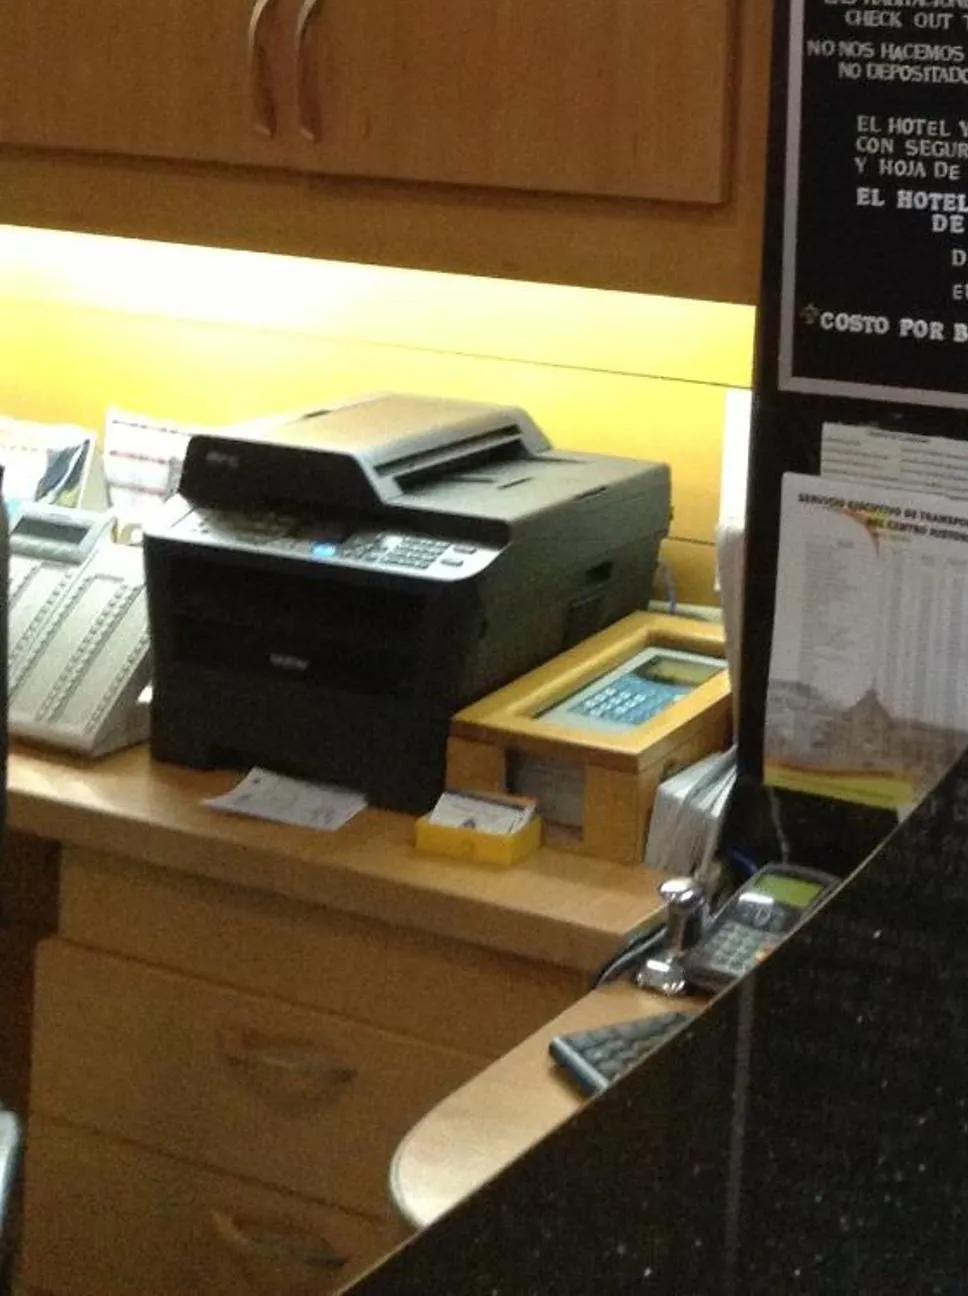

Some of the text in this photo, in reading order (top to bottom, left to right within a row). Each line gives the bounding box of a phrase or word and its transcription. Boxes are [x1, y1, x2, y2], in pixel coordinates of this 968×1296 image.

[844, 10, 903, 28] CHECK
[914, 12, 953, 30] OUT
[806, 40, 835, 58] NO
[839, 41, 875, 59] NOS
[880, 43, 965, 62] HACEMOS
[838, 62, 864, 79] NO
[856, 115, 880, 134] EL
[888, 118, 951, 137] HOTEL
[856, 136, 899, 155] CON
[855, 155, 867, 173] Y
[879, 158, 926, 177] HOJA
[934, 161, 960, 179] DE
[856, 187, 885, 207] EL
[931, 213, 965, 233] DE
[819, 310, 890, 334] COSTO
[899, 318, 944, 340] POR
